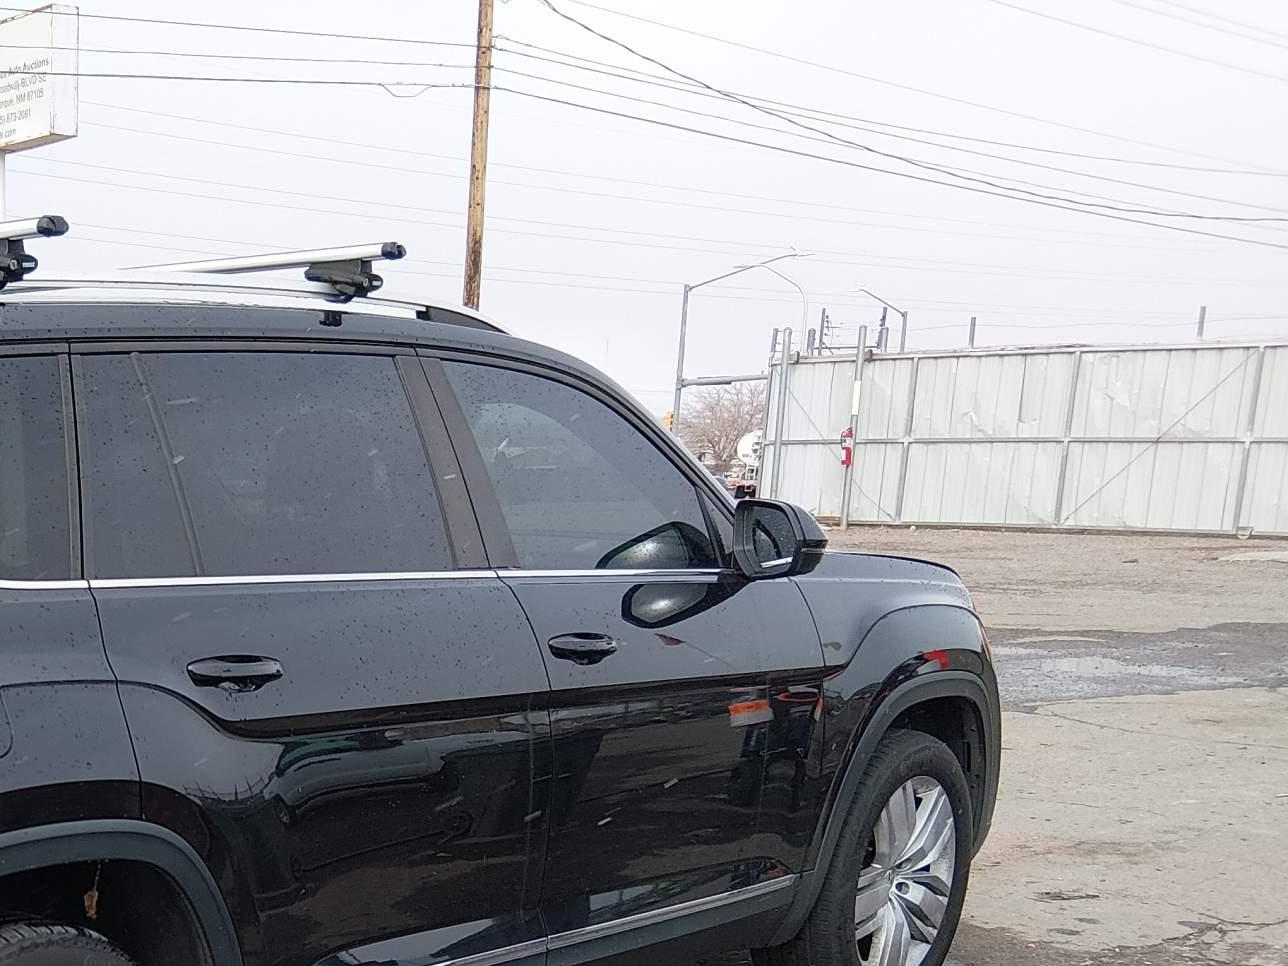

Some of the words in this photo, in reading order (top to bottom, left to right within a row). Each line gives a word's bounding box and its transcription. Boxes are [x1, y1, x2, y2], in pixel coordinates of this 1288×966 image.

[22, 57, 49, 72] Auctions
[21, 75, 37, 88] BLVD
[16, 91, 26, 104] NM
